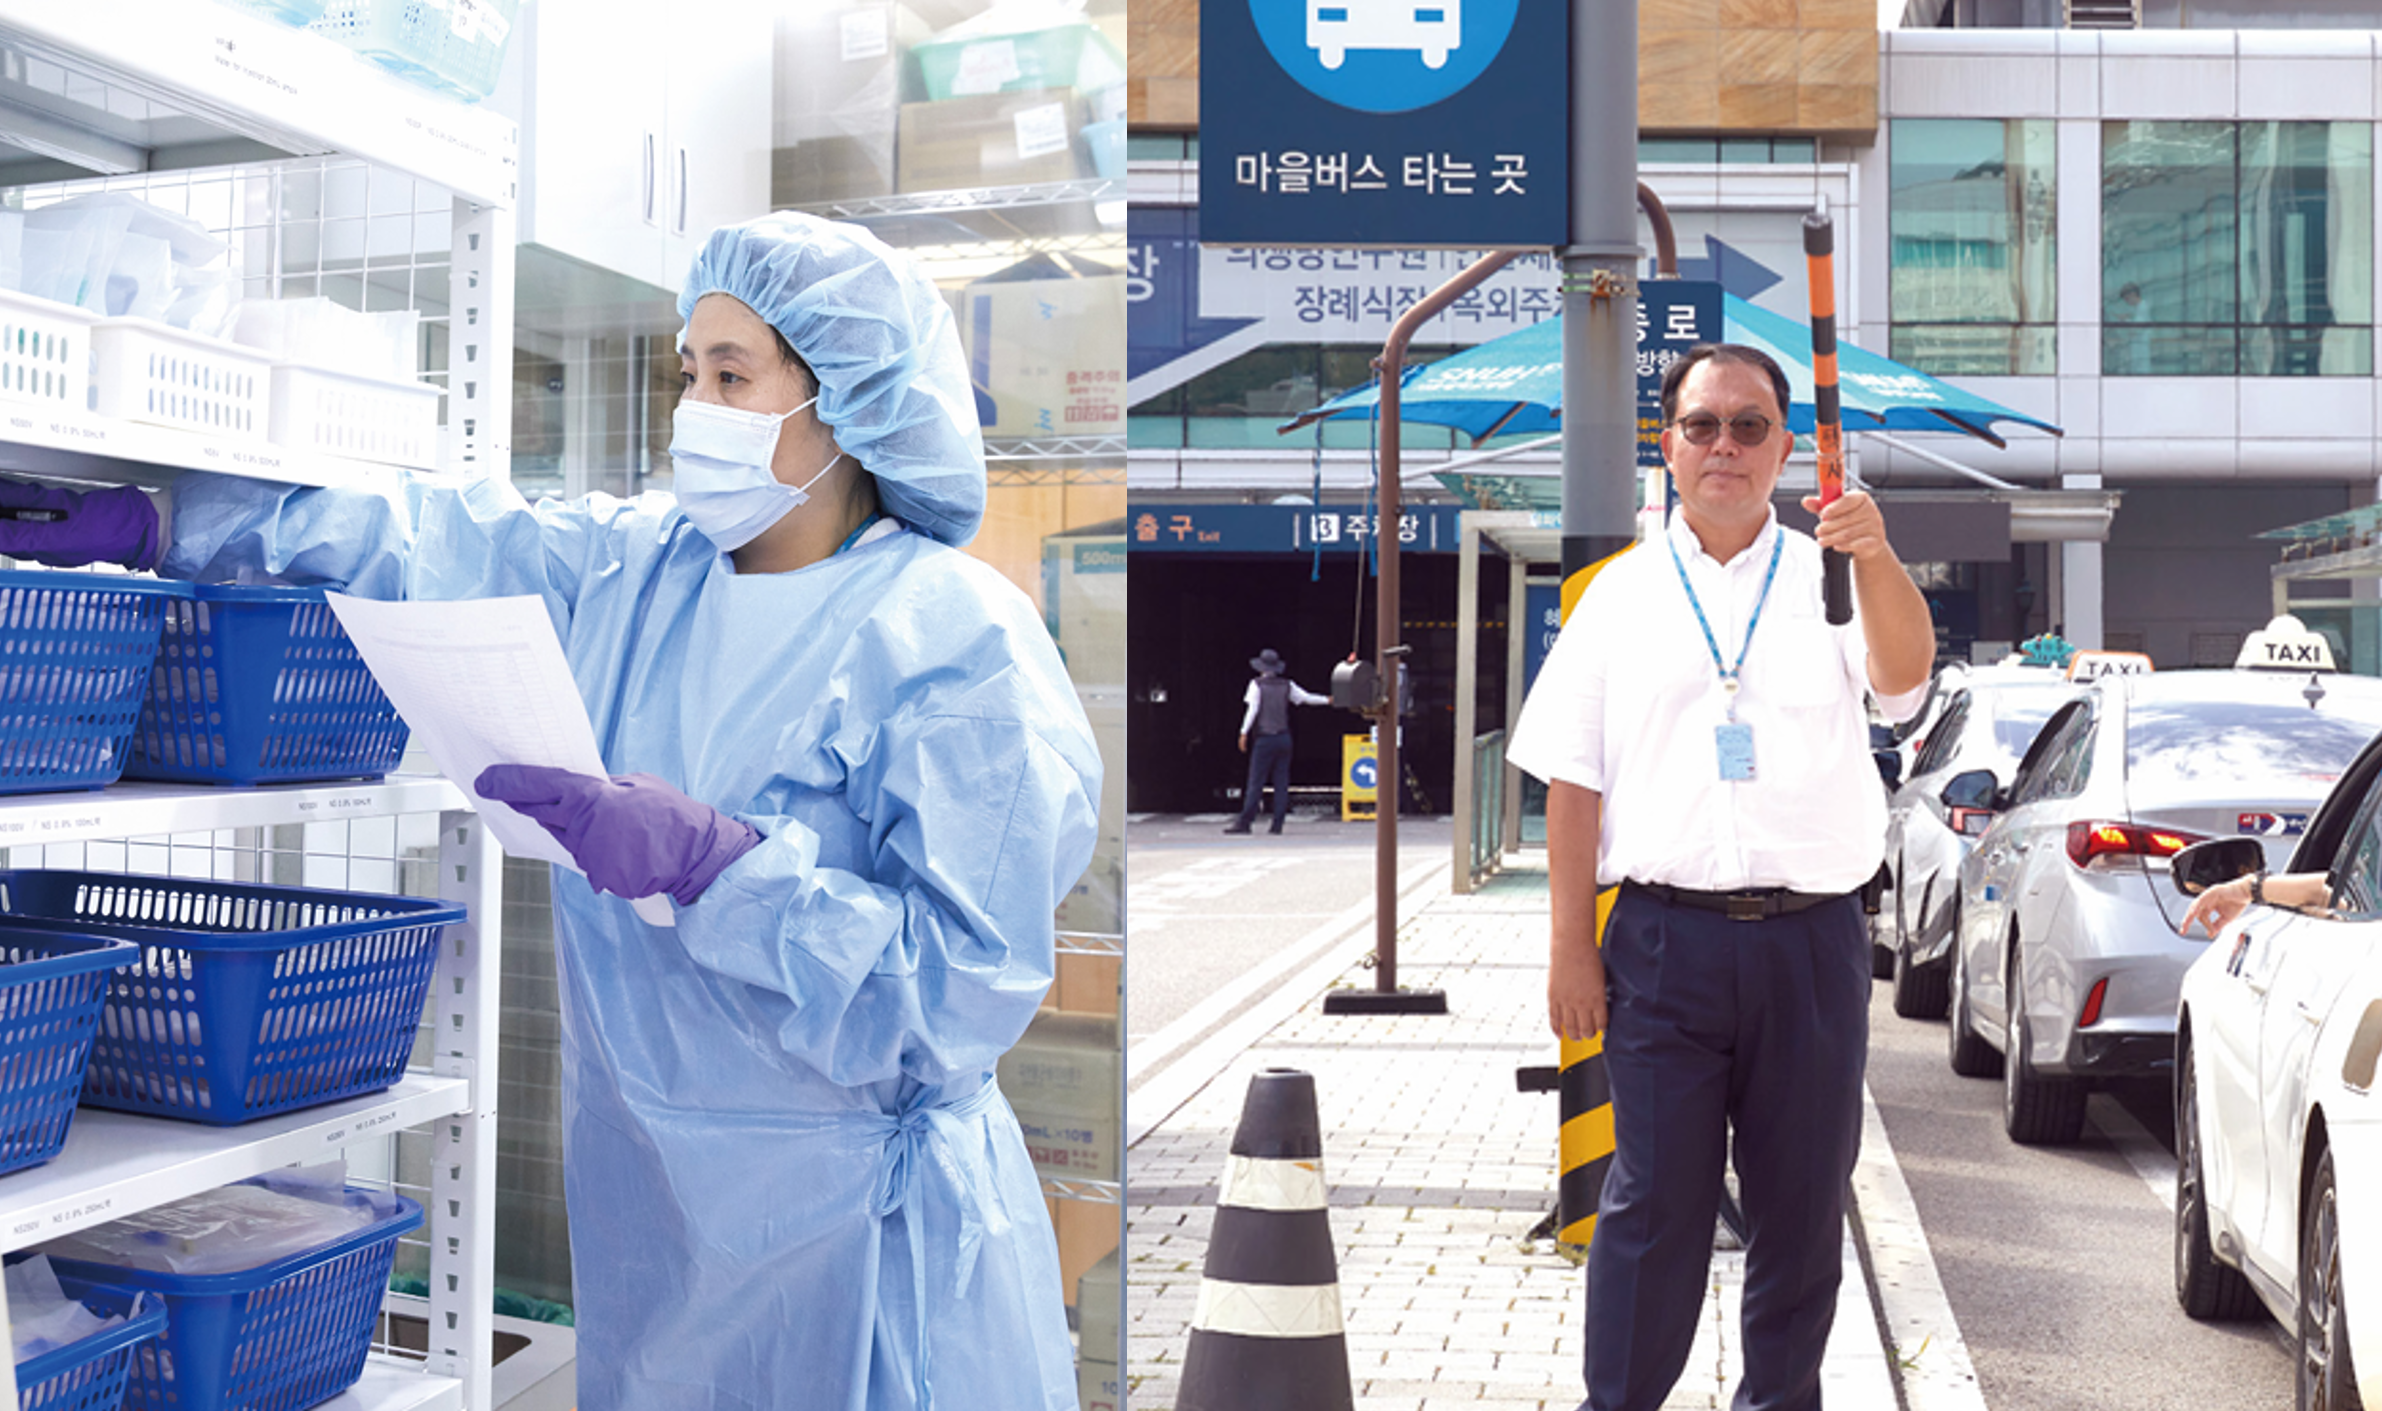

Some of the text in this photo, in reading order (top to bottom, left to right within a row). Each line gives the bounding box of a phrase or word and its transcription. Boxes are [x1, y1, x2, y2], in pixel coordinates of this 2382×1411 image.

[1236, 151, 1528, 194] 마을버스 타는 곳
[1345, 515, 1419, 543] 주장
[2265, 643, 2321, 662] TAXI
[2087, 661, 2142, 677] TAXI
